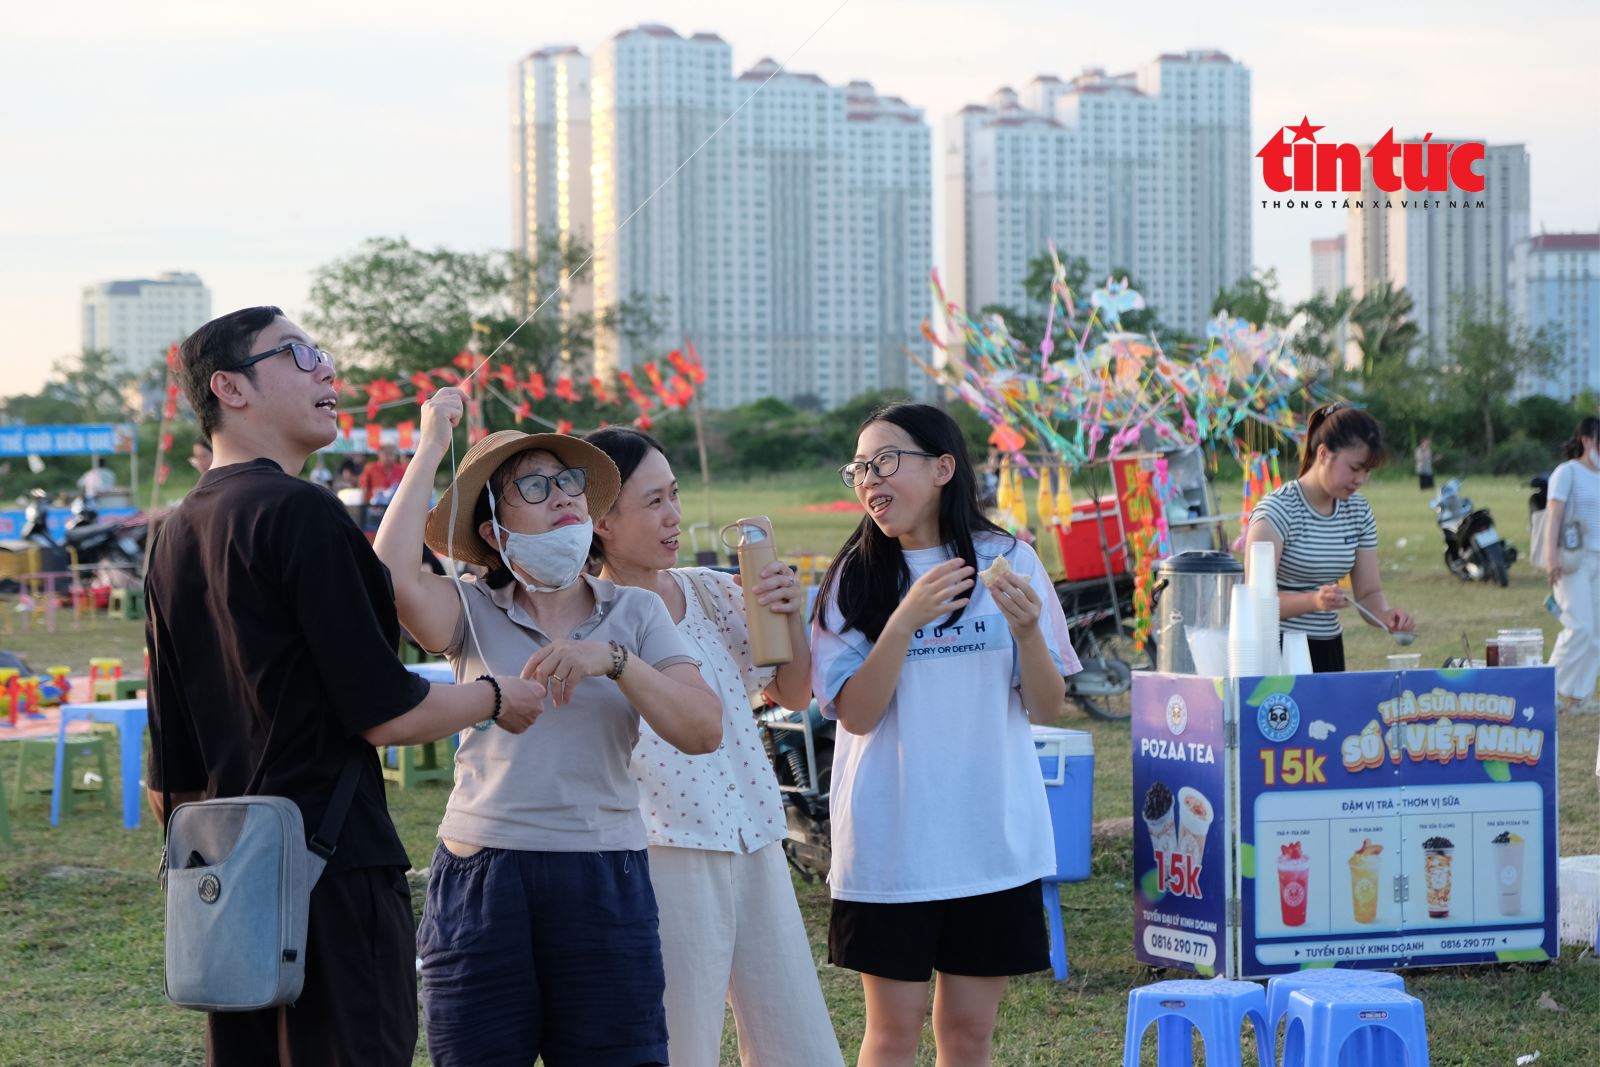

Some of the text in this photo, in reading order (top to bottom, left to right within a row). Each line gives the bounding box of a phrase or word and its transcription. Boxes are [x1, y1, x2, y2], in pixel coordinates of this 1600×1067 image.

[914, 620, 986, 639] OUTH
[906, 642, 986, 657] CTORY OR DEFEAT
[1458, 692, 1516, 724] NGON
[1141, 738, 1215, 764] POZAA TEA
[1341, 720, 1385, 773] SỐ
[1405, 717, 1476, 765] VIỆT
[1475, 724, 1545, 766] NAM
[1259, 747, 1328, 786] 15k
[1365, 800, 1375, 812] VỊ
[1377, 797, 1394, 810] TRÀ
[1432, 798, 1441, 809] VỊ
[1154, 850, 1202, 899] 15k
[1195, 920, 1217, 933] DOANH
[1151, 933, 1208, 957] 0816 290 777
[1368, 945, 1389, 954] KINH
[1391, 941, 1424, 953] DOANH
[1441, 940, 1461, 949] 0816
[1463, 938, 1479, 948] 290
[1481, 937, 1495, 947] 777
